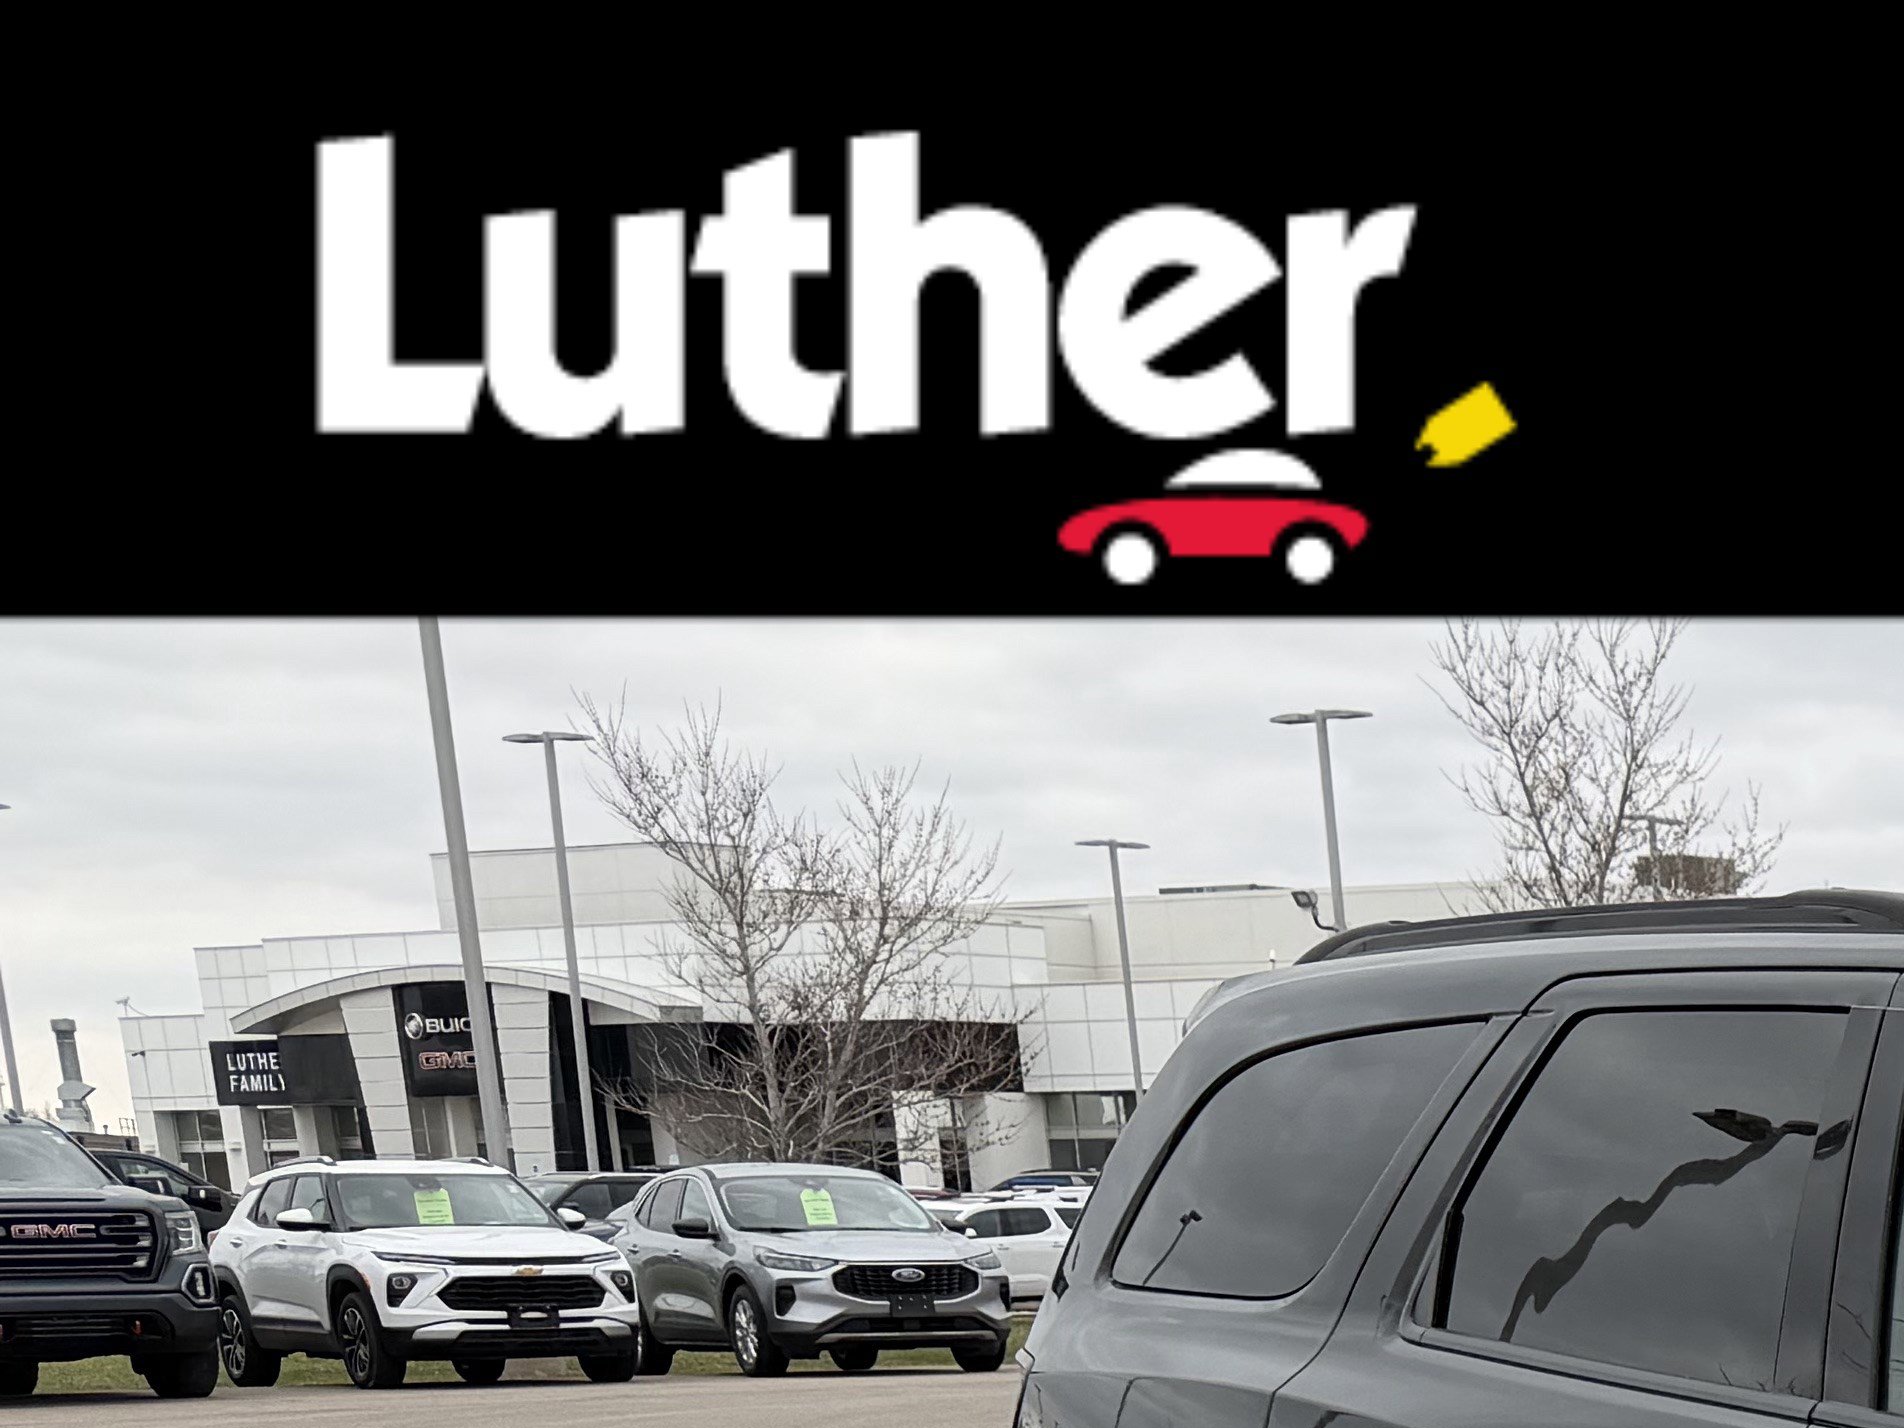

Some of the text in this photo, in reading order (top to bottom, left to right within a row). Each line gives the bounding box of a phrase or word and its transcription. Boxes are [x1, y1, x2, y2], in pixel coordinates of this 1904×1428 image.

[425, 1017, 472, 1033] BUIC
[226, 1052, 280, 1071] LUTHE
[419, 1050, 477, 1070] GMC
[11, 1223, 97, 1239] GMC
